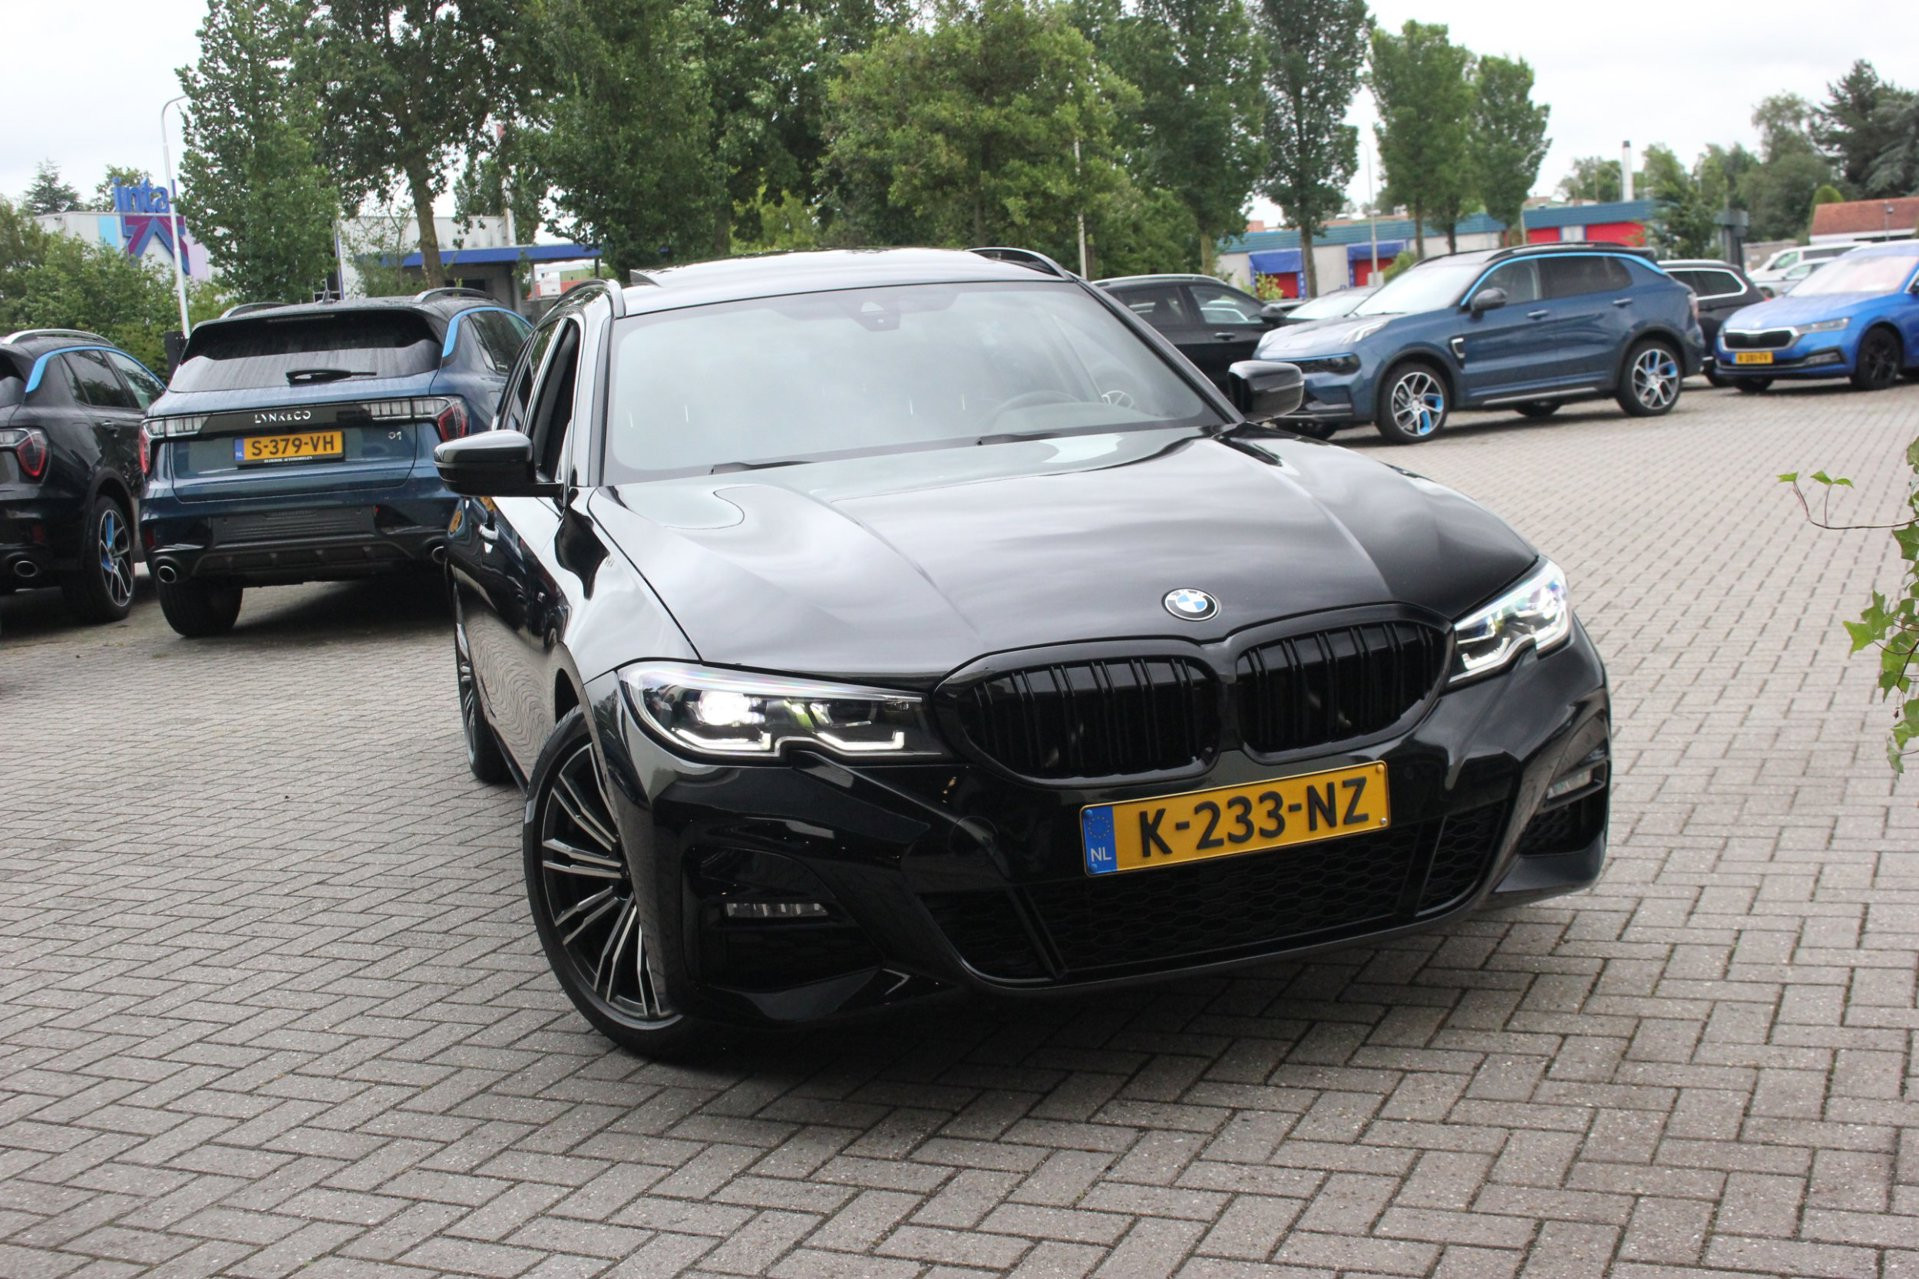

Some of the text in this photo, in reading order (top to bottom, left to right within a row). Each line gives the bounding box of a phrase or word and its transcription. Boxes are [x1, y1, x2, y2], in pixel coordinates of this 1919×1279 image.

[251, 434, 335, 457] S-379-VH
[1138, 775, 1370, 858] K-233-NZ
[1090, 847, 1112, 862] NL
